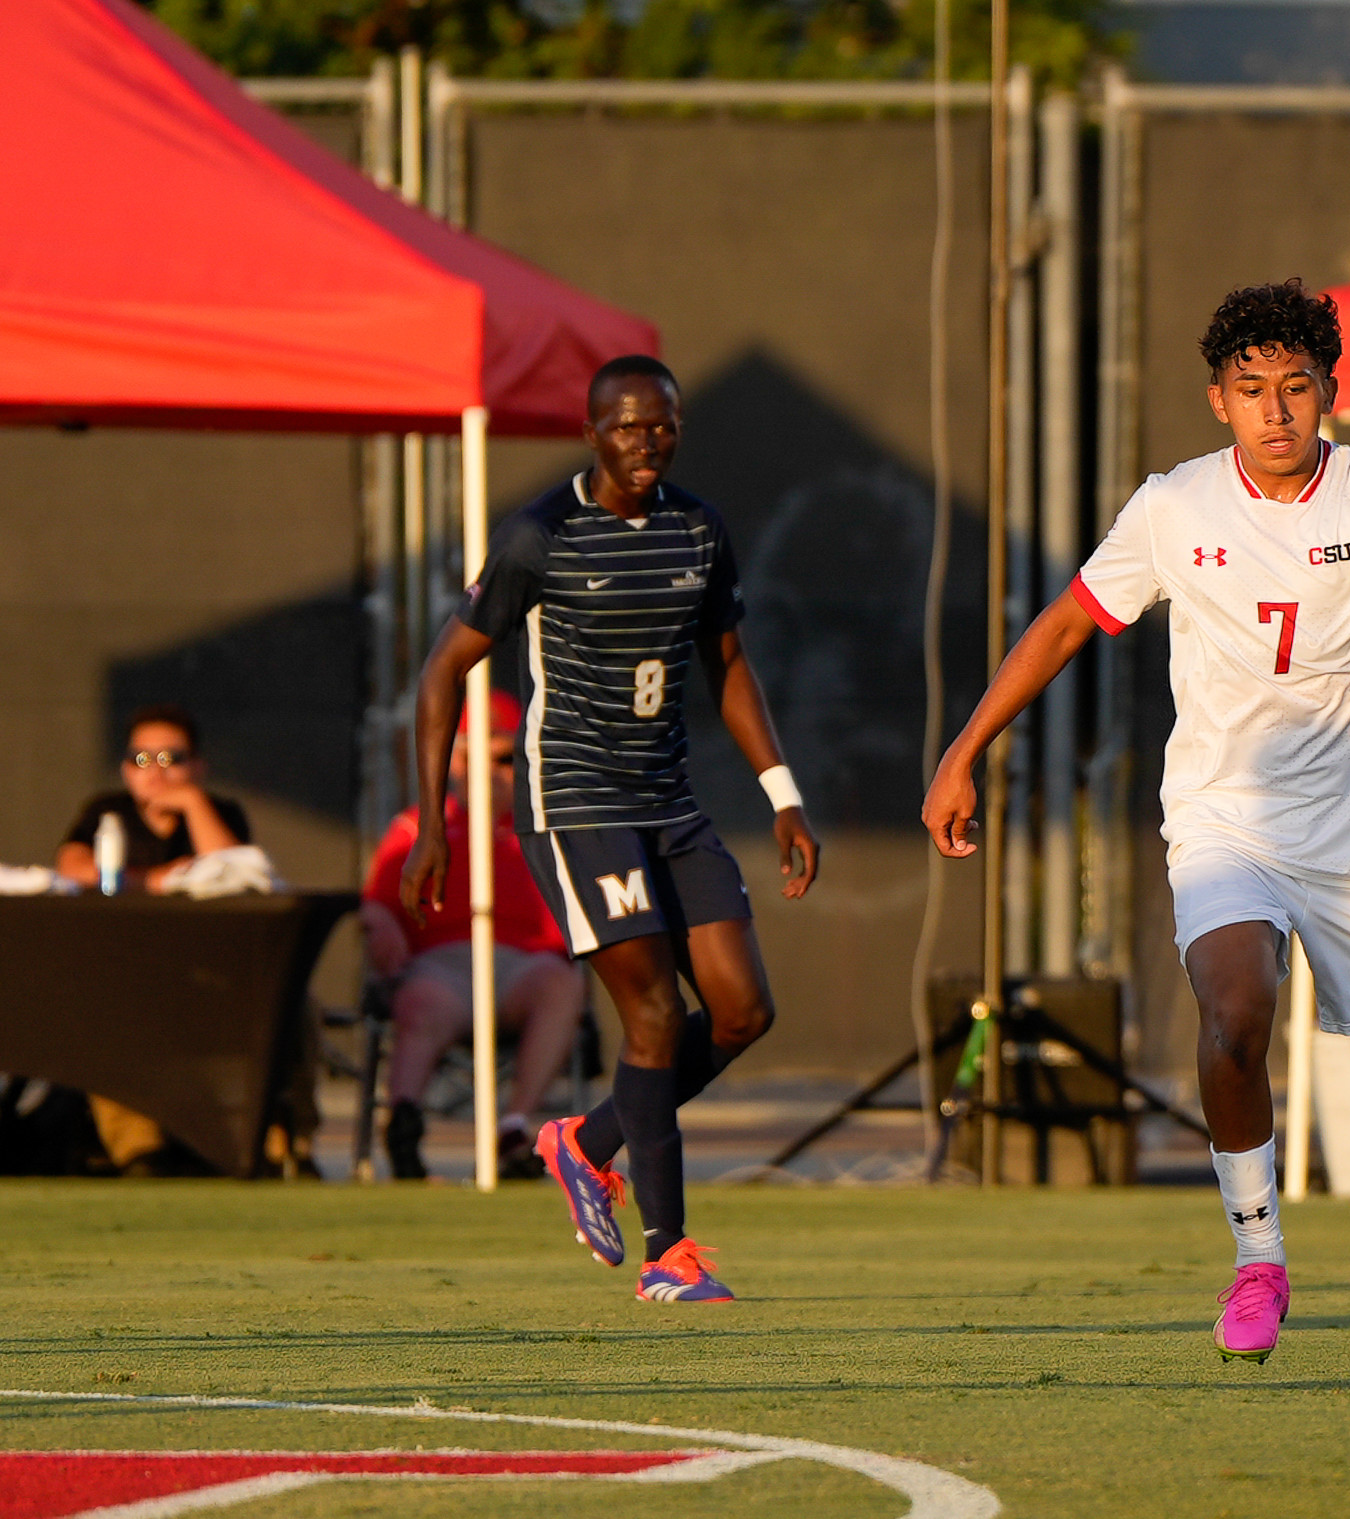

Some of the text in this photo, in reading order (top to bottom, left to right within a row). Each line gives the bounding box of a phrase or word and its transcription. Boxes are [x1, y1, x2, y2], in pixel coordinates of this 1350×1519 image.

[1257, 602, 1299, 674] 7
[633, 659, 665, 717] 8
[596, 867, 651, 919] M
